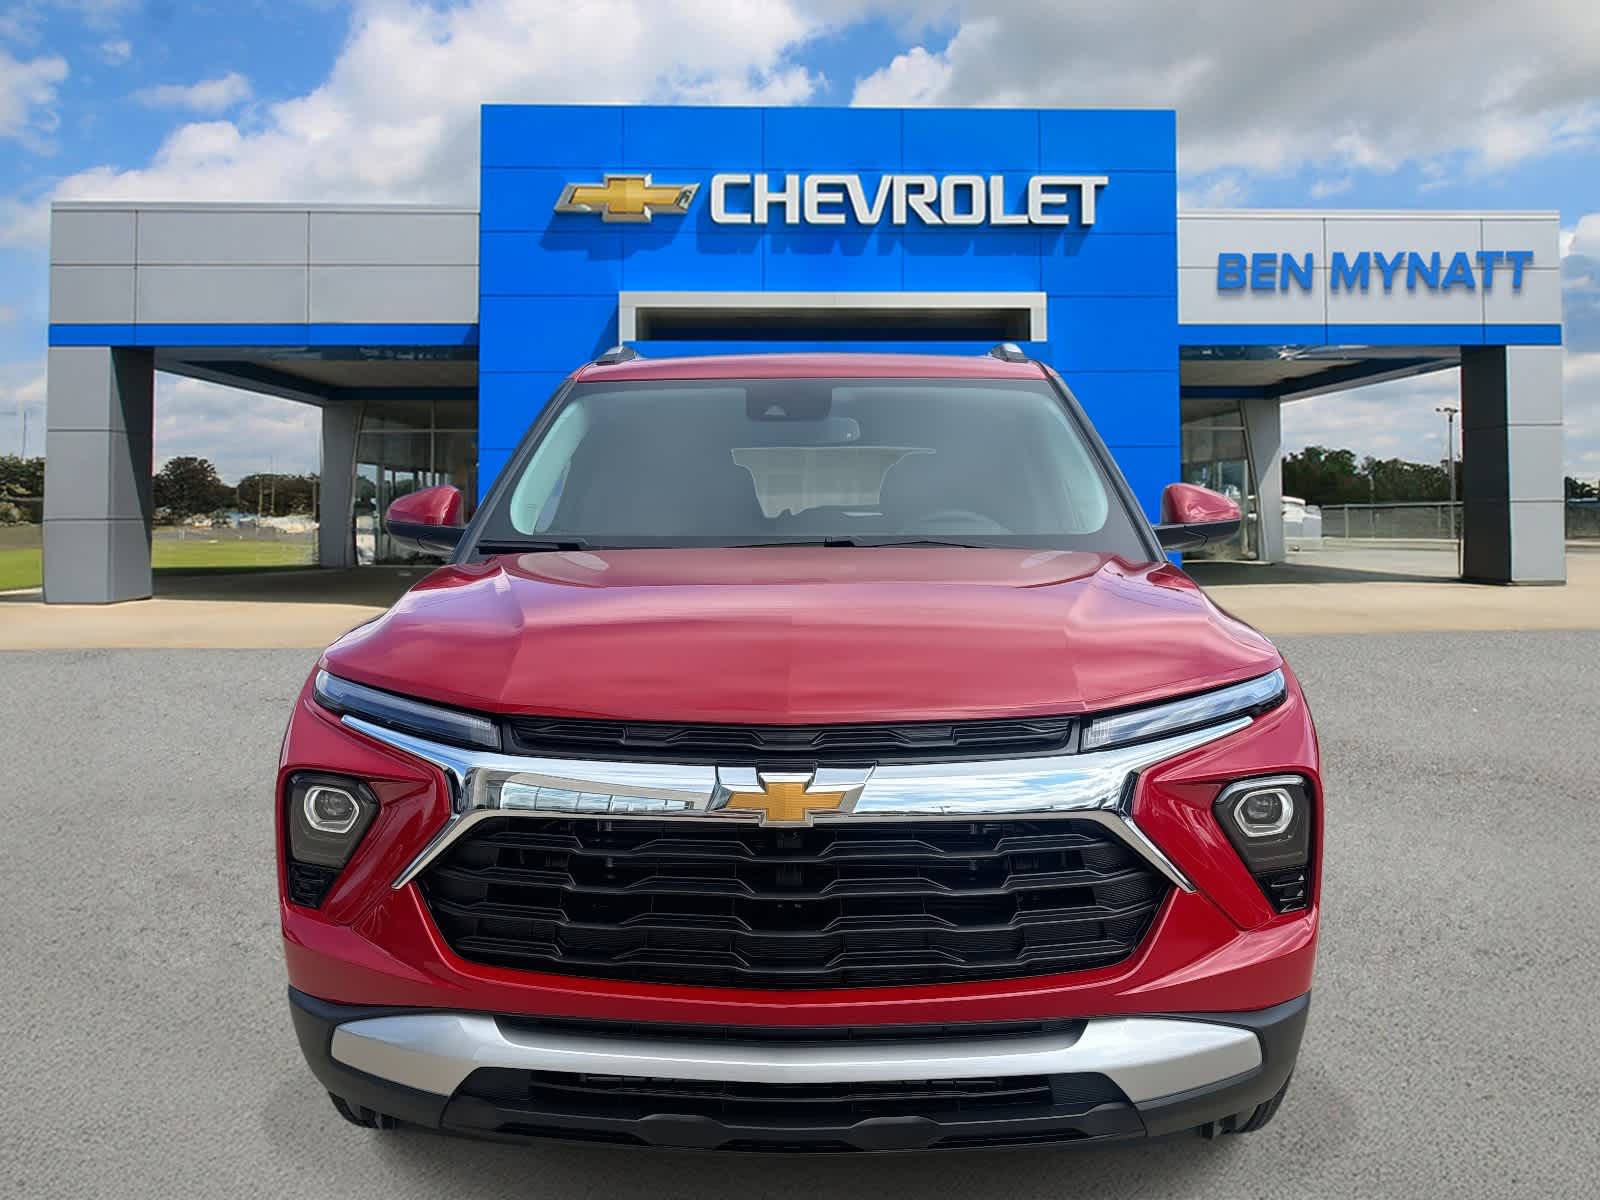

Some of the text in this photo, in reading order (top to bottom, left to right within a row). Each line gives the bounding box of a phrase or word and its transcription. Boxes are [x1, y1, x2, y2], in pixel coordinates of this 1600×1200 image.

[710, 174, 1109, 225] CHEVROLET
[1217, 251, 1534, 290] BEN MYNATT
